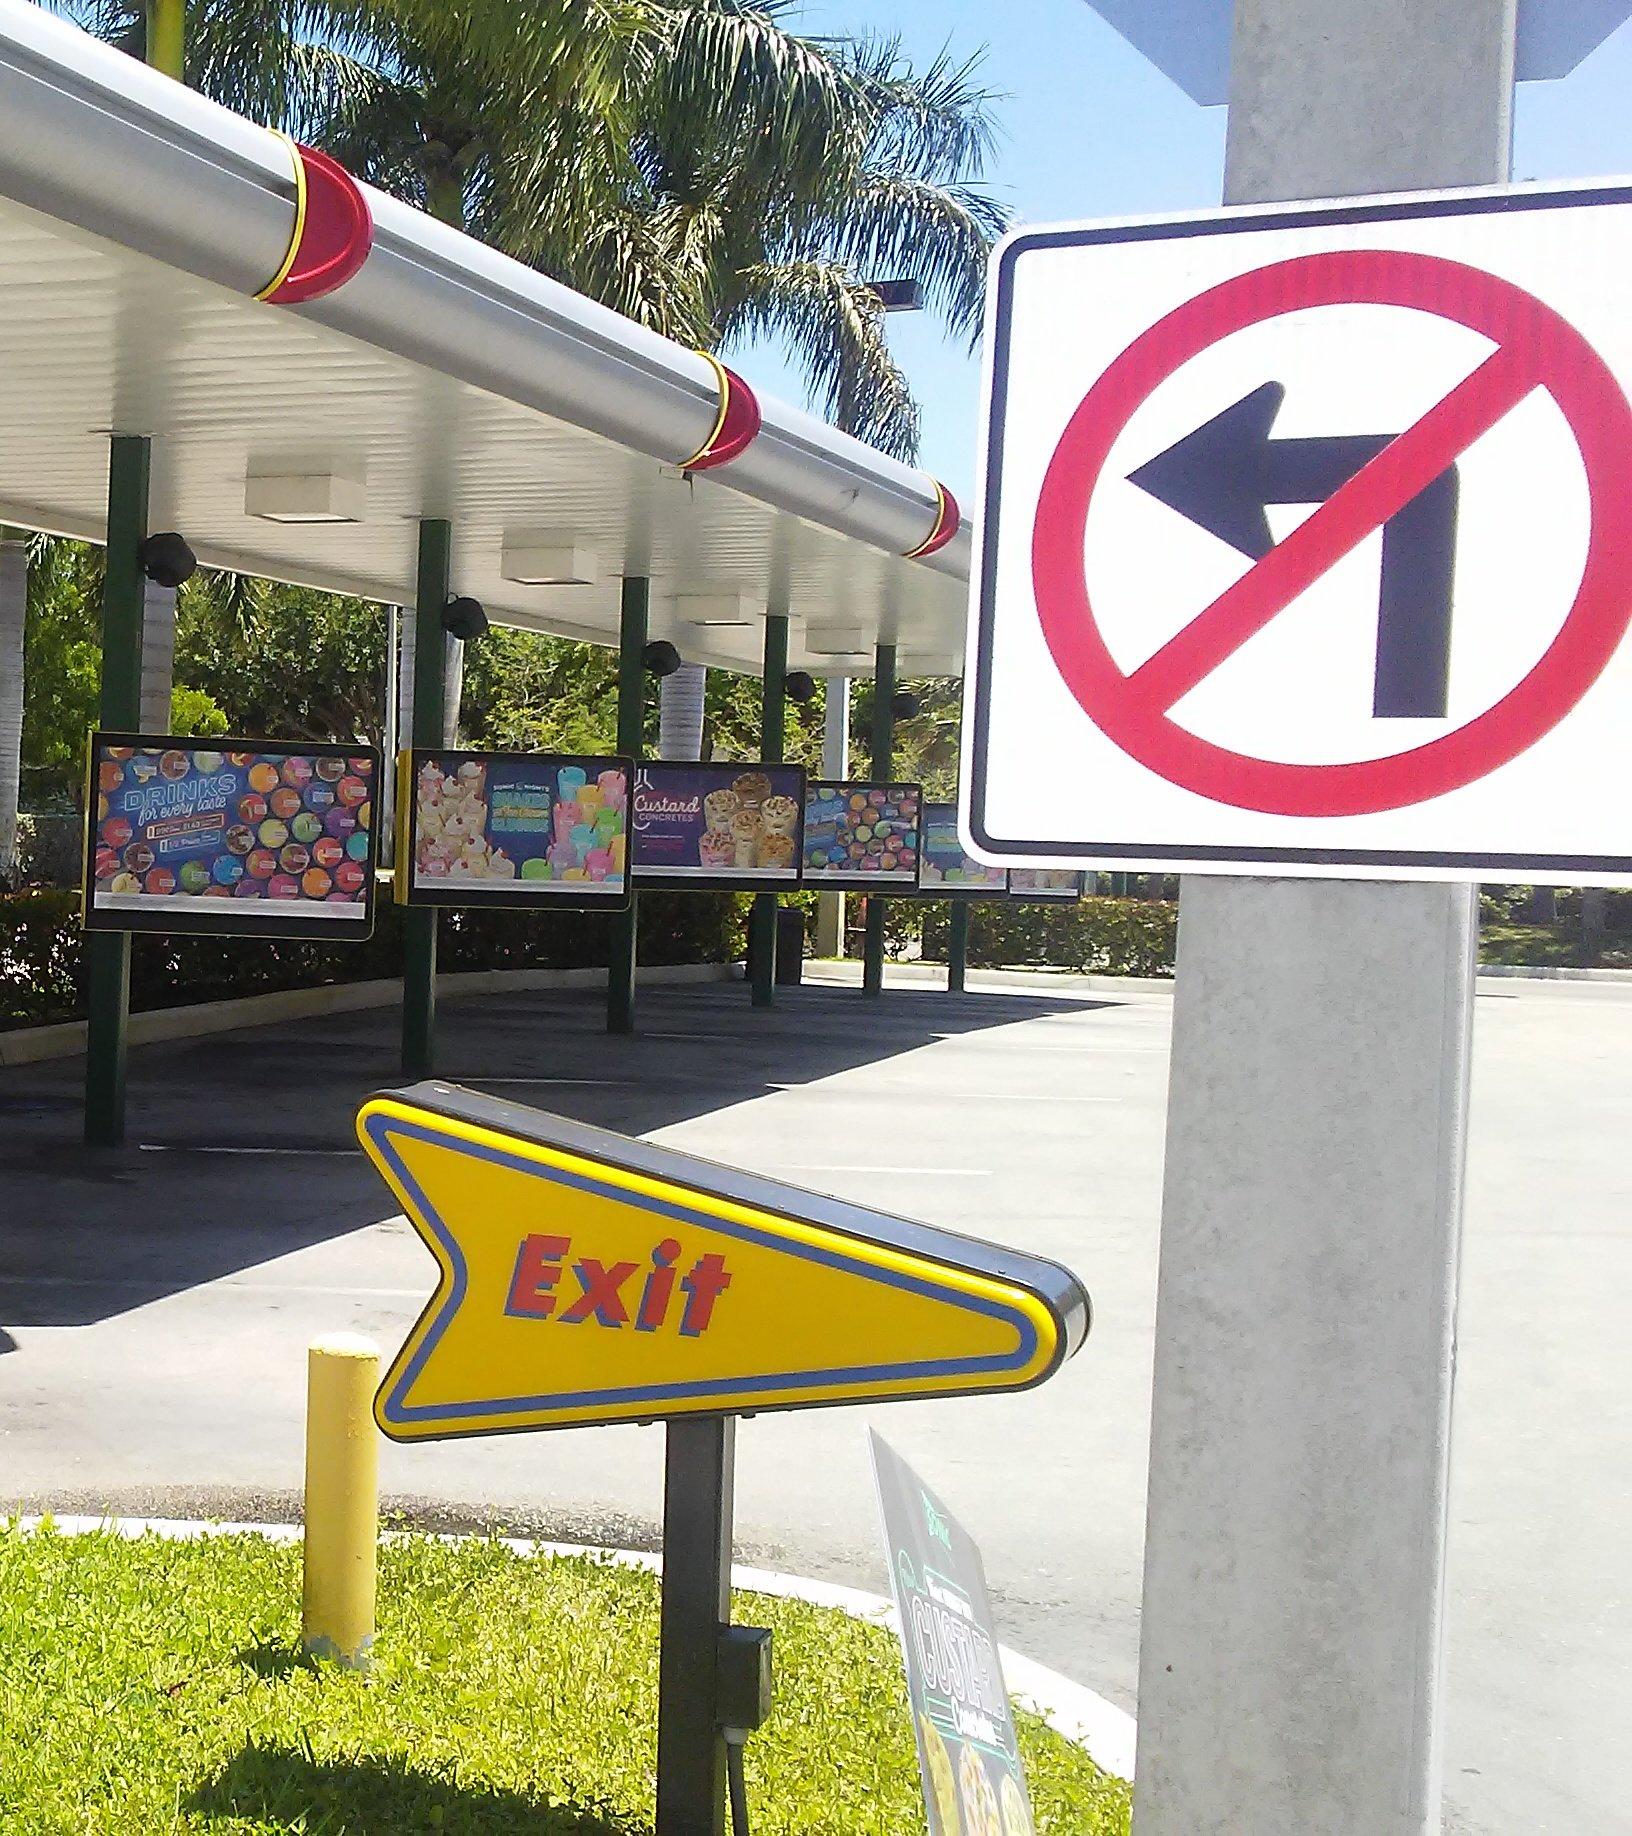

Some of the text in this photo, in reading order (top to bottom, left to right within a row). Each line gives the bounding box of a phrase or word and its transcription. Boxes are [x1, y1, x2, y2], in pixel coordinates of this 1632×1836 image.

[124, 773, 237, 812] DRINKS
[634, 794, 701, 814] Custard
[138, 795, 227, 827] for every taste
[503, 1232, 732, 1337] Exit
